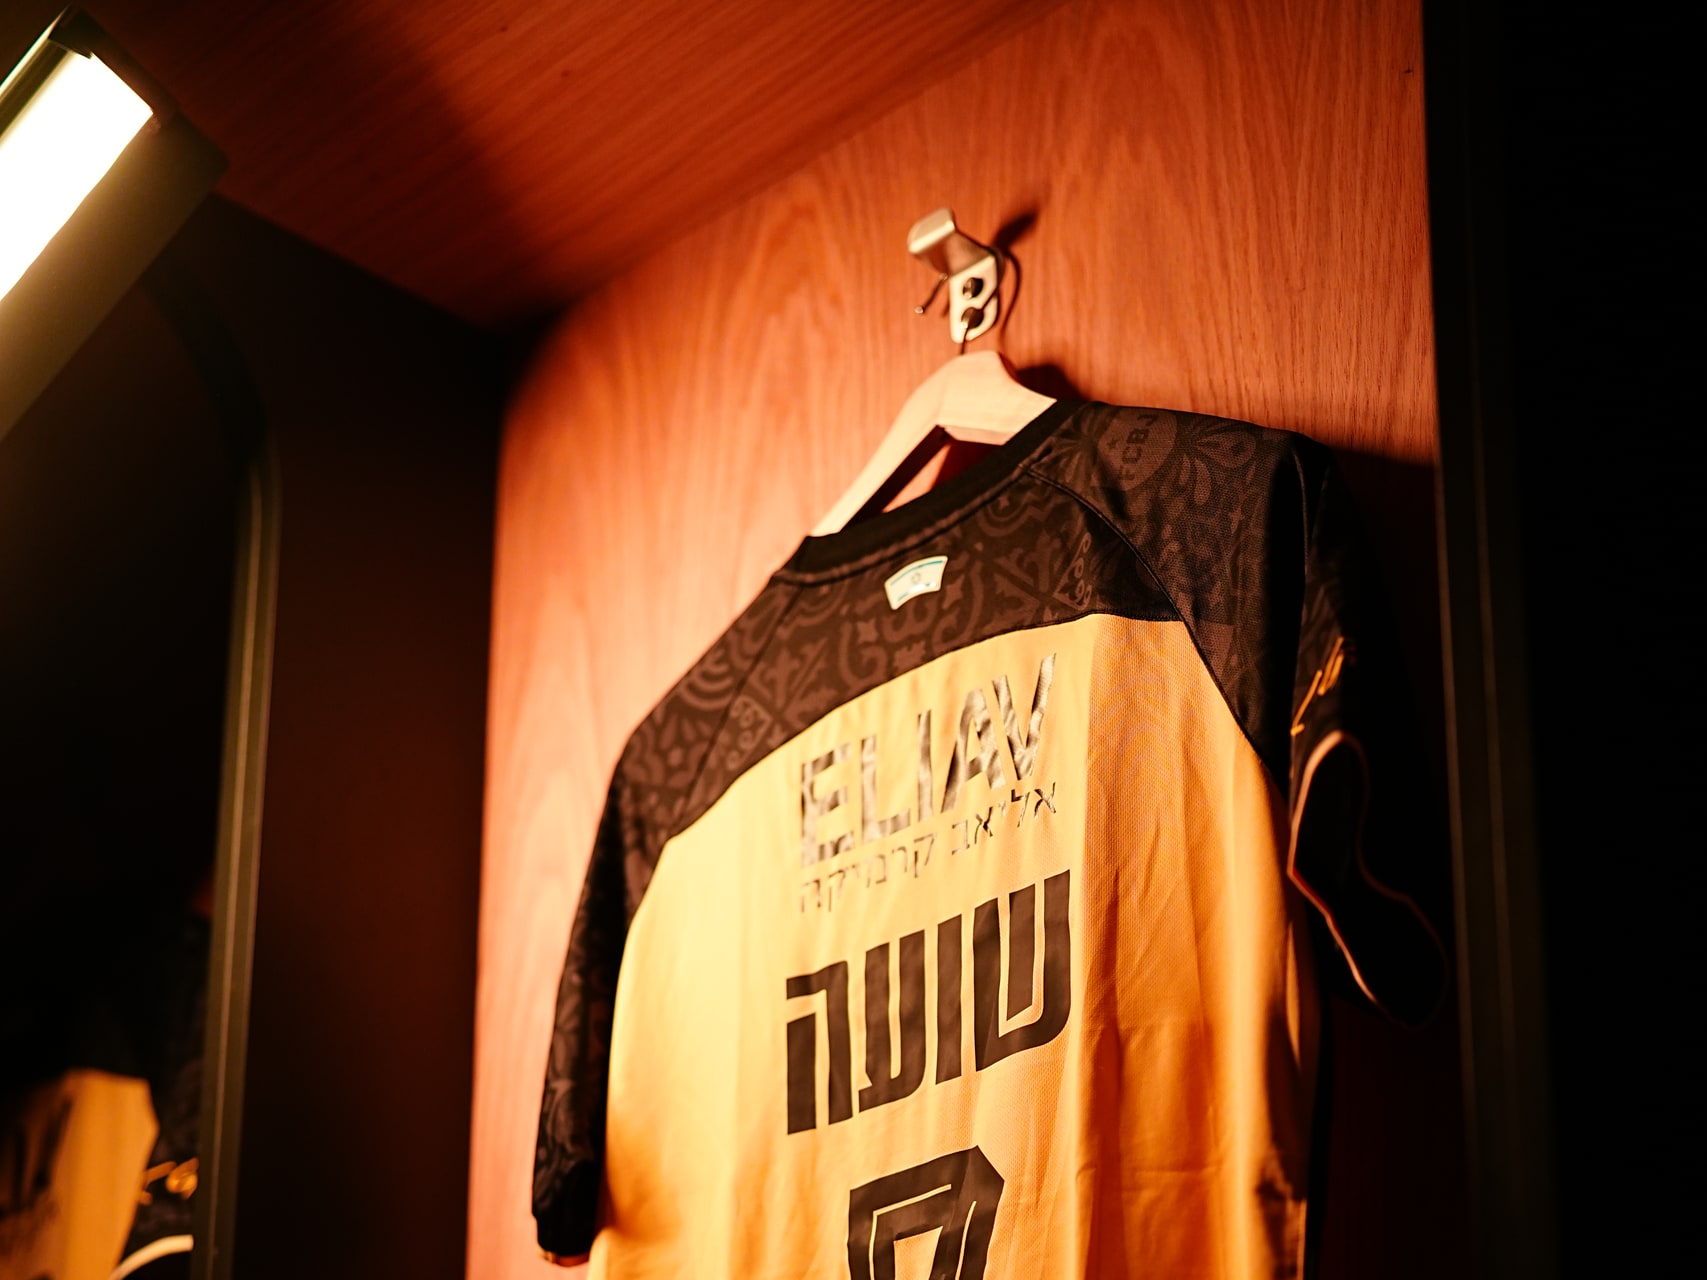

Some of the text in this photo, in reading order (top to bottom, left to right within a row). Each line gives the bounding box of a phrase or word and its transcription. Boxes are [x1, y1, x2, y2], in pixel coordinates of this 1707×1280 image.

[800, 653, 1056, 870] ELIAV
[951, 781, 1056, 856] אליאב
[786, 869, 1072, 1135] שועה
